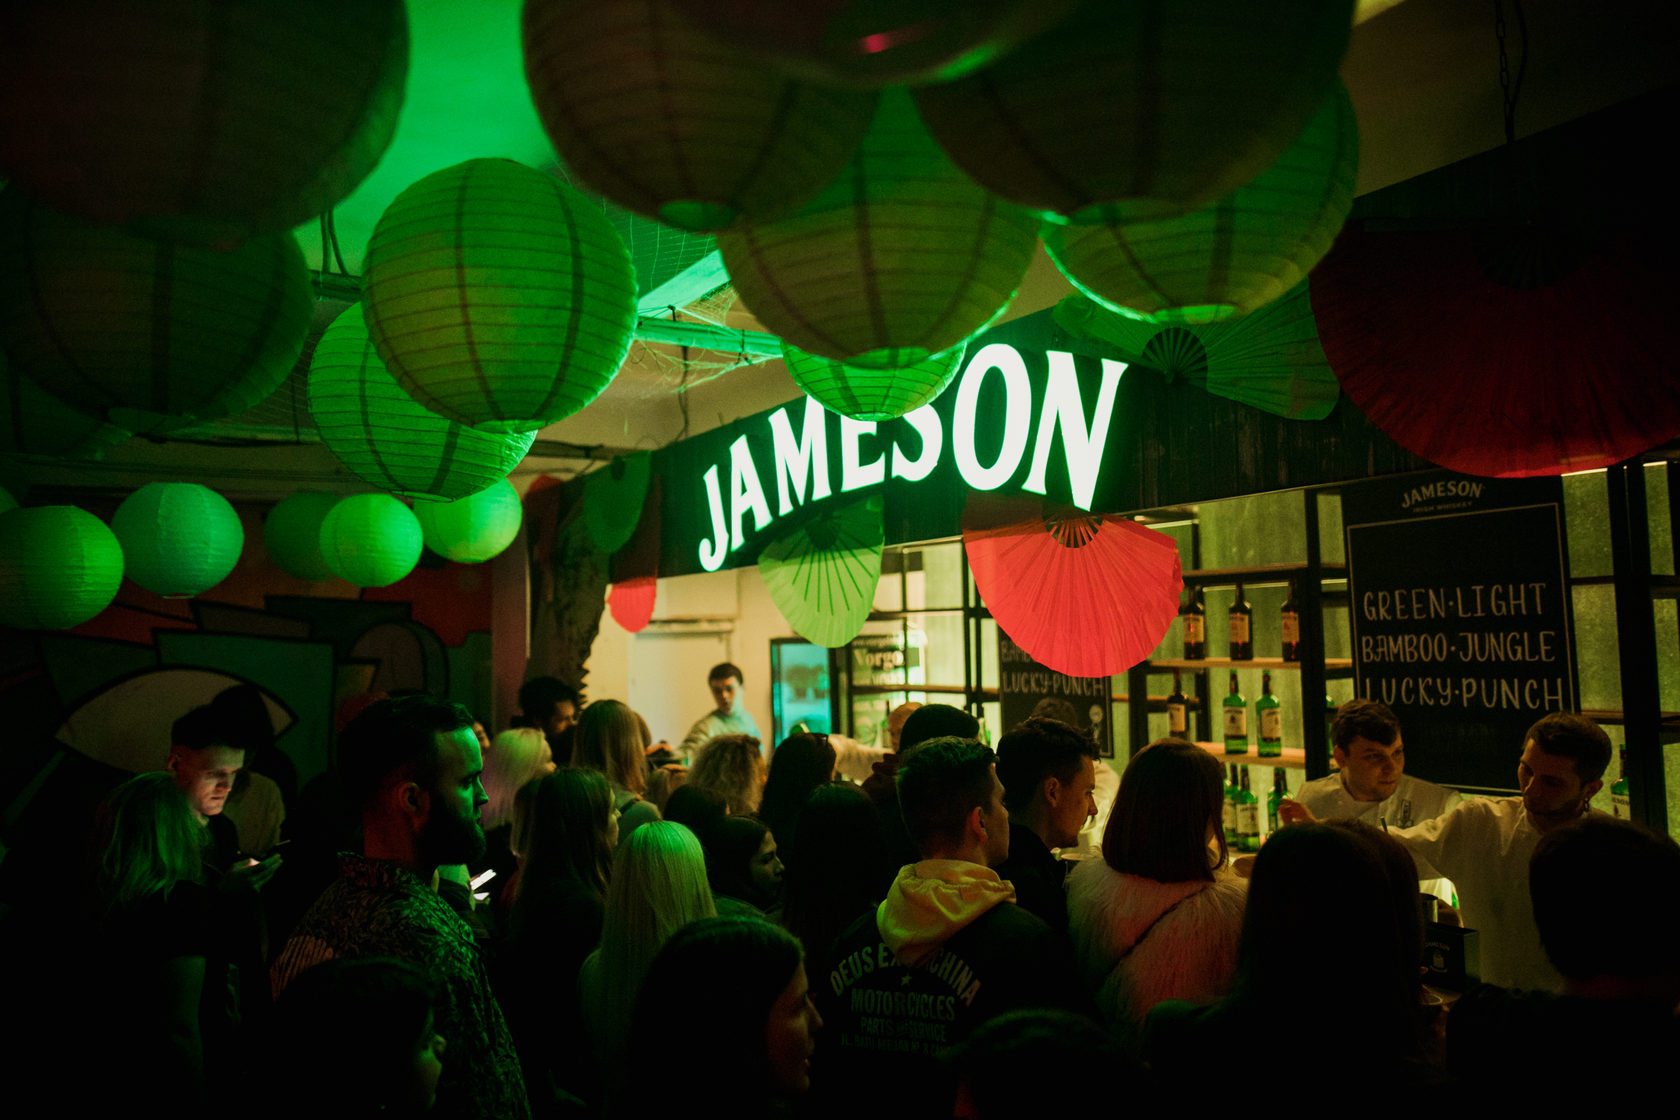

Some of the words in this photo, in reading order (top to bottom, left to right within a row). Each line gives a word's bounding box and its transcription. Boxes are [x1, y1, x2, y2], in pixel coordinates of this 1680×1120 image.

[699, 343, 1128, 571] JAMESON
[1401, 481, 1483, 508] JAMESON
[829, 945, 875, 997] DEUS
[850, 988, 956, 1023] MOTORCYCLES
